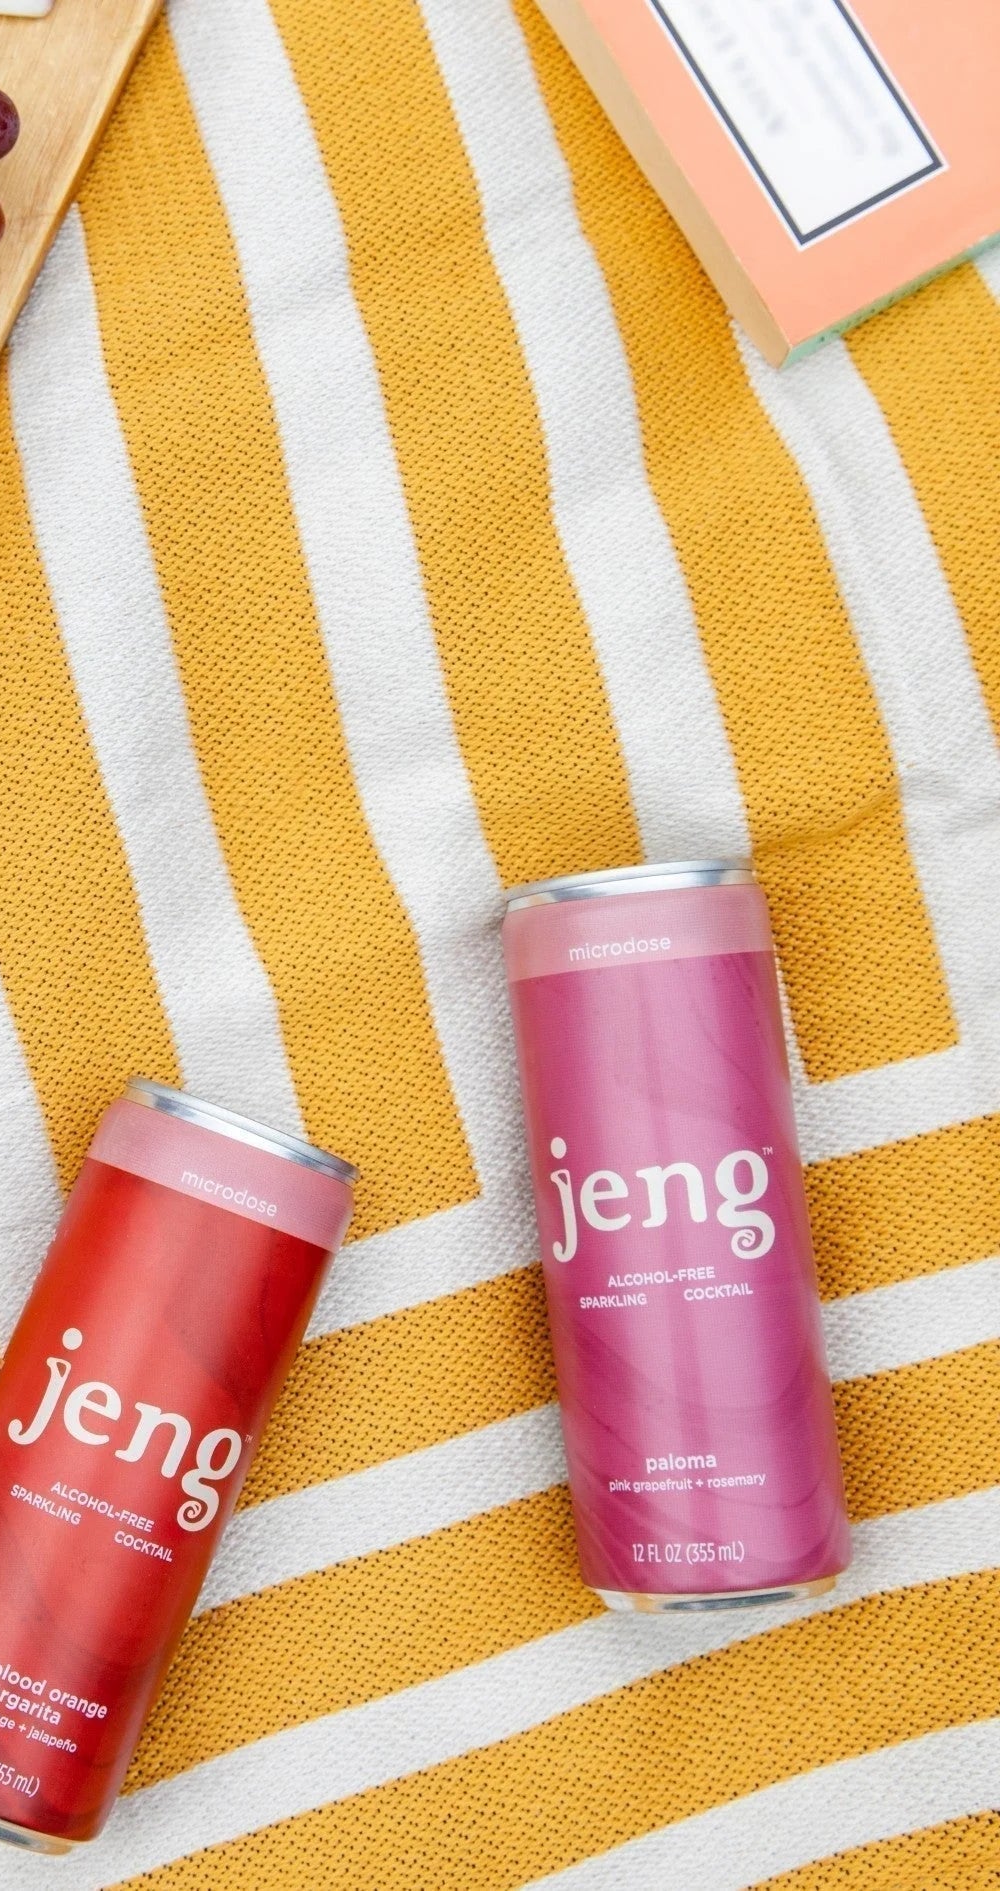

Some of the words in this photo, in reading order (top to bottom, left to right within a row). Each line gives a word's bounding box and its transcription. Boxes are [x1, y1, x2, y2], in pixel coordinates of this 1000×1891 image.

[568, 934, 672, 963] microdose
[181, 1170, 278, 1217] microdose
[550, 1136, 777, 1264] jeng
[607, 1266, 716, 1289] ALCOHOL-FREE
[579, 1291, 648, 1310] SPARKLING
[683, 1282, 754, 1301] COCKTAIL
[7, 1327, 243, 1532] jeng
[645, 1453, 717, 1474] paloma
[609, 1479, 632, 1493] pink
[632, 1476, 693, 1493] grapefruit
[707, 1473, 767, 1490] rosemary
[50, 1481, 156, 1533] ALCOHOL-FREE
[10, 1484, 82, 1525] SPARKLING
[113, 1530, 174, 1563] COCKTAIL
[631, 1543, 645, 1563] 12
[647, 1543, 662, 1563] FL
[665, 1543, 683, 1563] OZ
[686, 1542, 716, 1565] (355
[48, 1687, 109, 1721] orange
[27, 1725, 77, 1753] jalapeño
